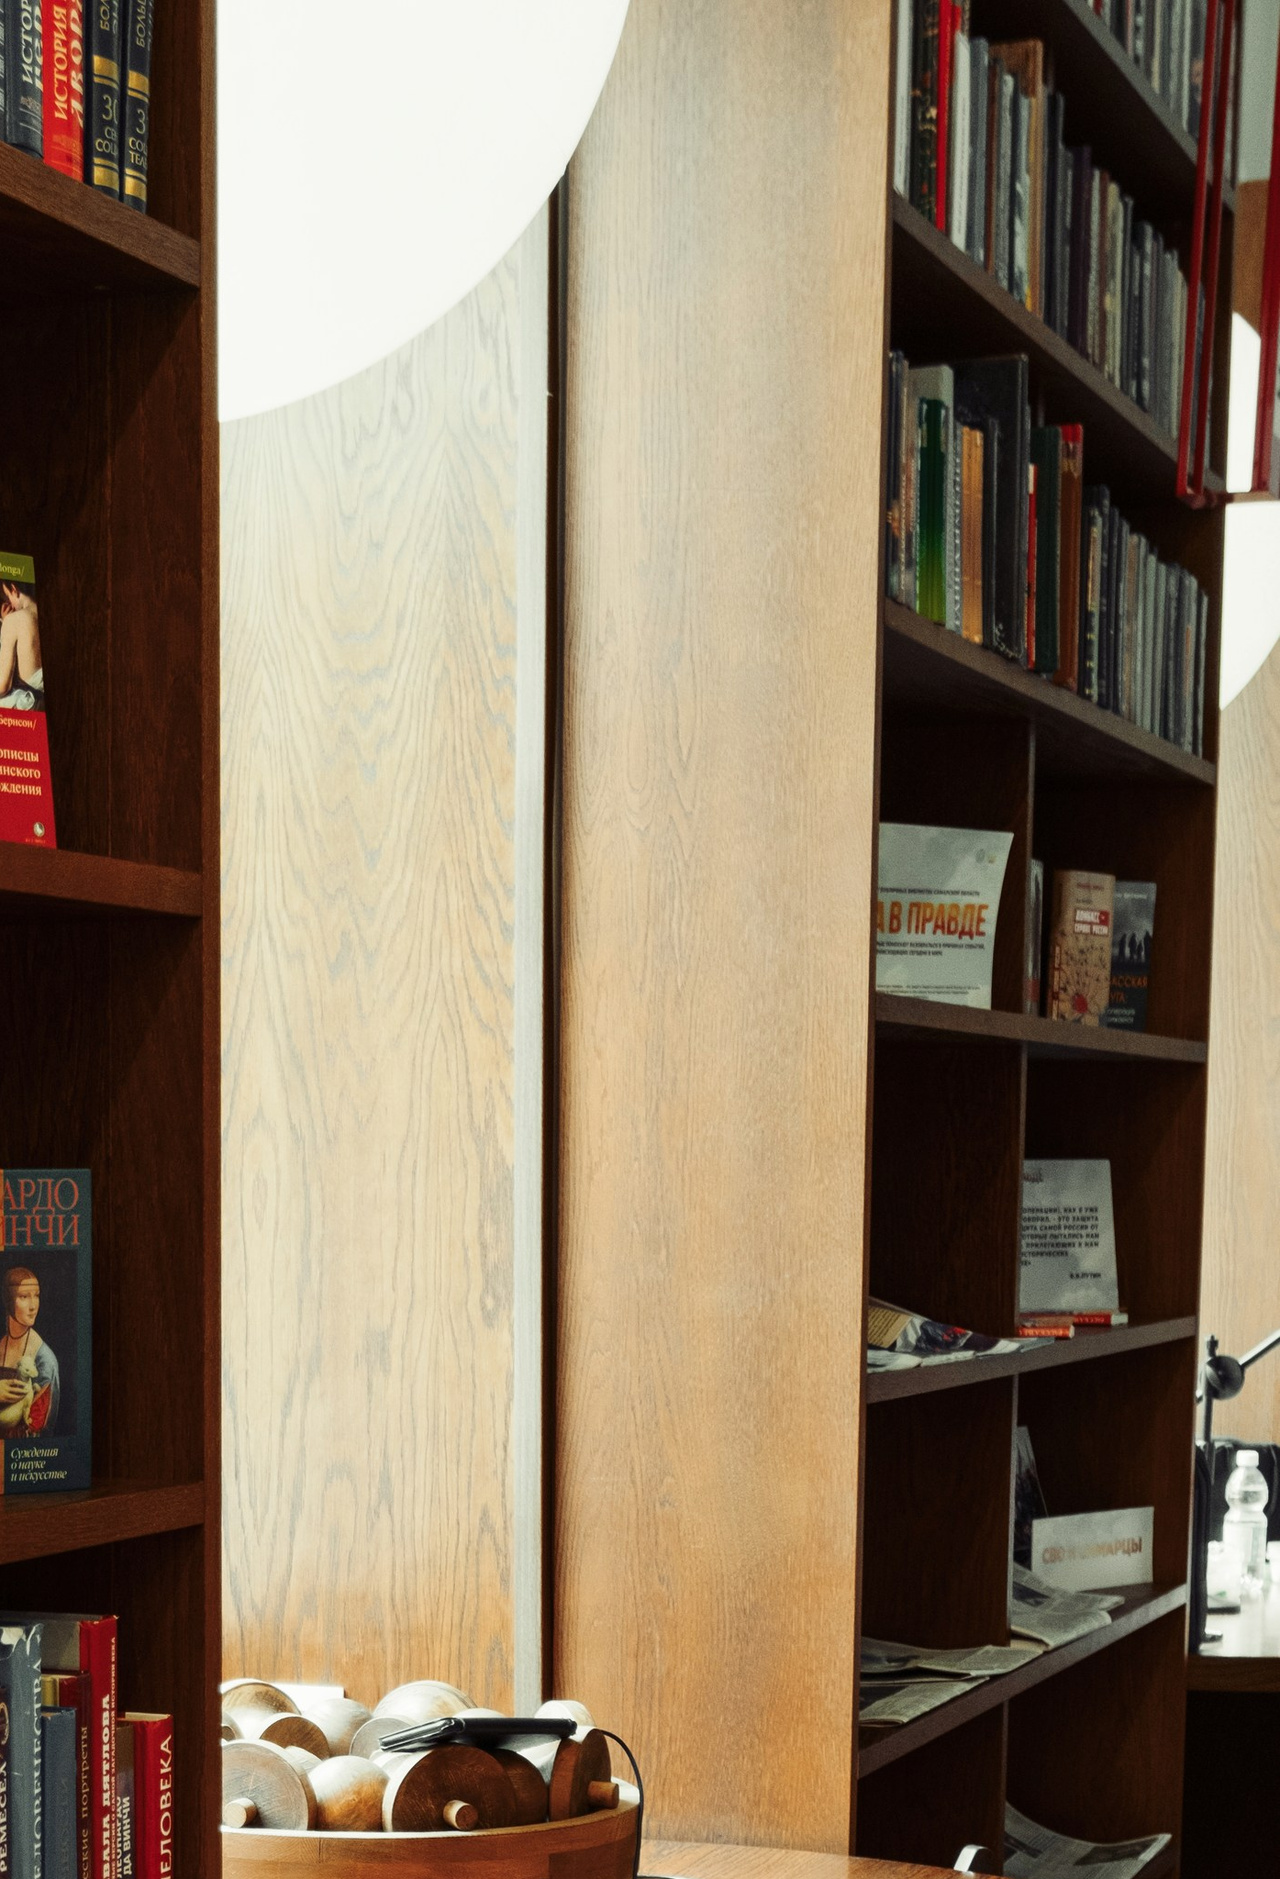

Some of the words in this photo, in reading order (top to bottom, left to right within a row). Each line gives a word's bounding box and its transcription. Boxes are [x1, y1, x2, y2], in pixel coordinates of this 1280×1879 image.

[53, 5, 68, 120] ИСТОРИЯ
[888, 901, 903, 937] В
[907, 903, 989, 941] ПРАВДЕ
[10, 1445, 59, 1461] Суждения
[18, 1460, 47, 1473] науке
[19, 1470, 68, 1484] искусстве
[78, 1725, 91, 1819] портреты
[101, 1694, 111, 1807] ДЯТЛОВА
[0, 1761, 9, 1873] РЕМЕСЕЛ
[122, 1796, 132, 1850] ВИНЧИ
[122, 1853, 133, 1876] ДА
